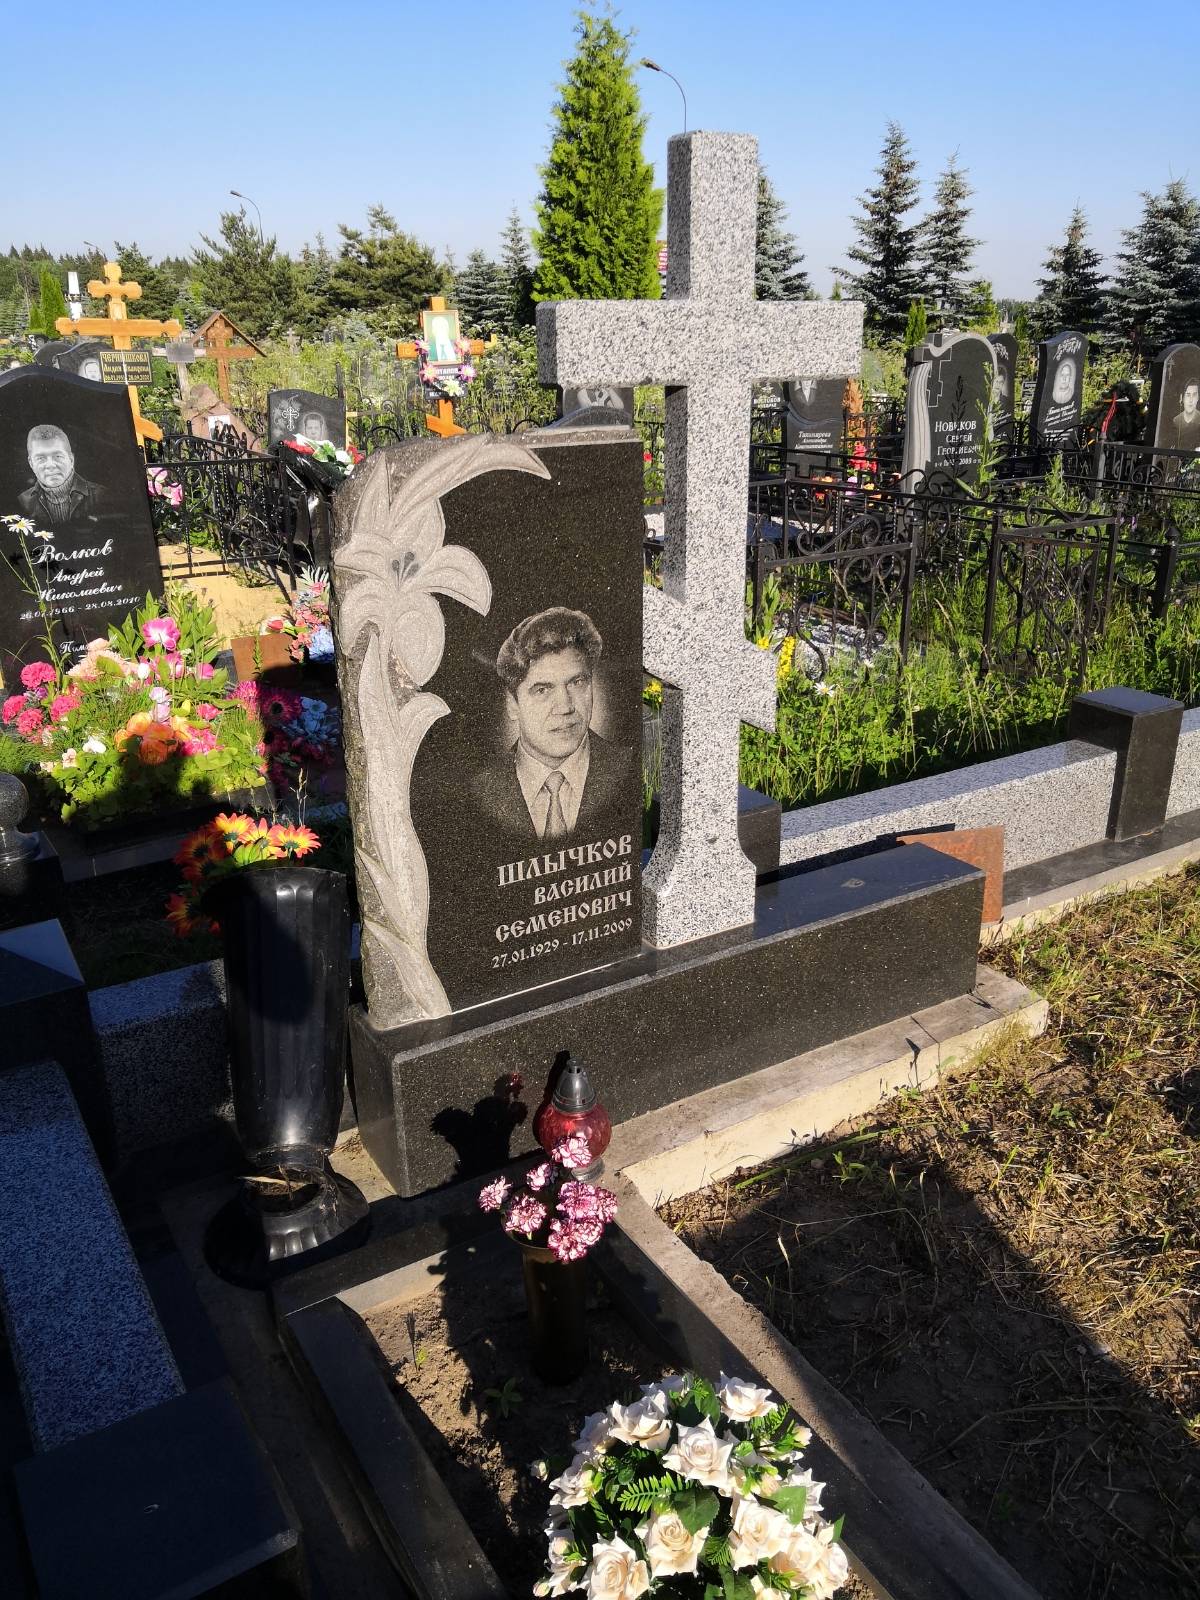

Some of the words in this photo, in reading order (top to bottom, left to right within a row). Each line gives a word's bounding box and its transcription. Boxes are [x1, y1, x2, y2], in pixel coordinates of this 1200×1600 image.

[937, 444, 981, 456] ГЕОРИЕВИЧ
[31, 538, 114, 565] Волков
[48, 566, 105, 586] Андрей
[35, 582, 123, 602] Николаевич
[85, 596, 140, 611] 28.08.2010
[497, 834, 632, 887] ШЛЫЧКОВ
[533, 860, 632, 905] ВАСИЛИЙ
[495, 890, 632, 942] СЕМЕНОВИЧ
[492, 939, 560, 969] 27.01.1929
[571, 917, 633, 946] 17.11.2009
